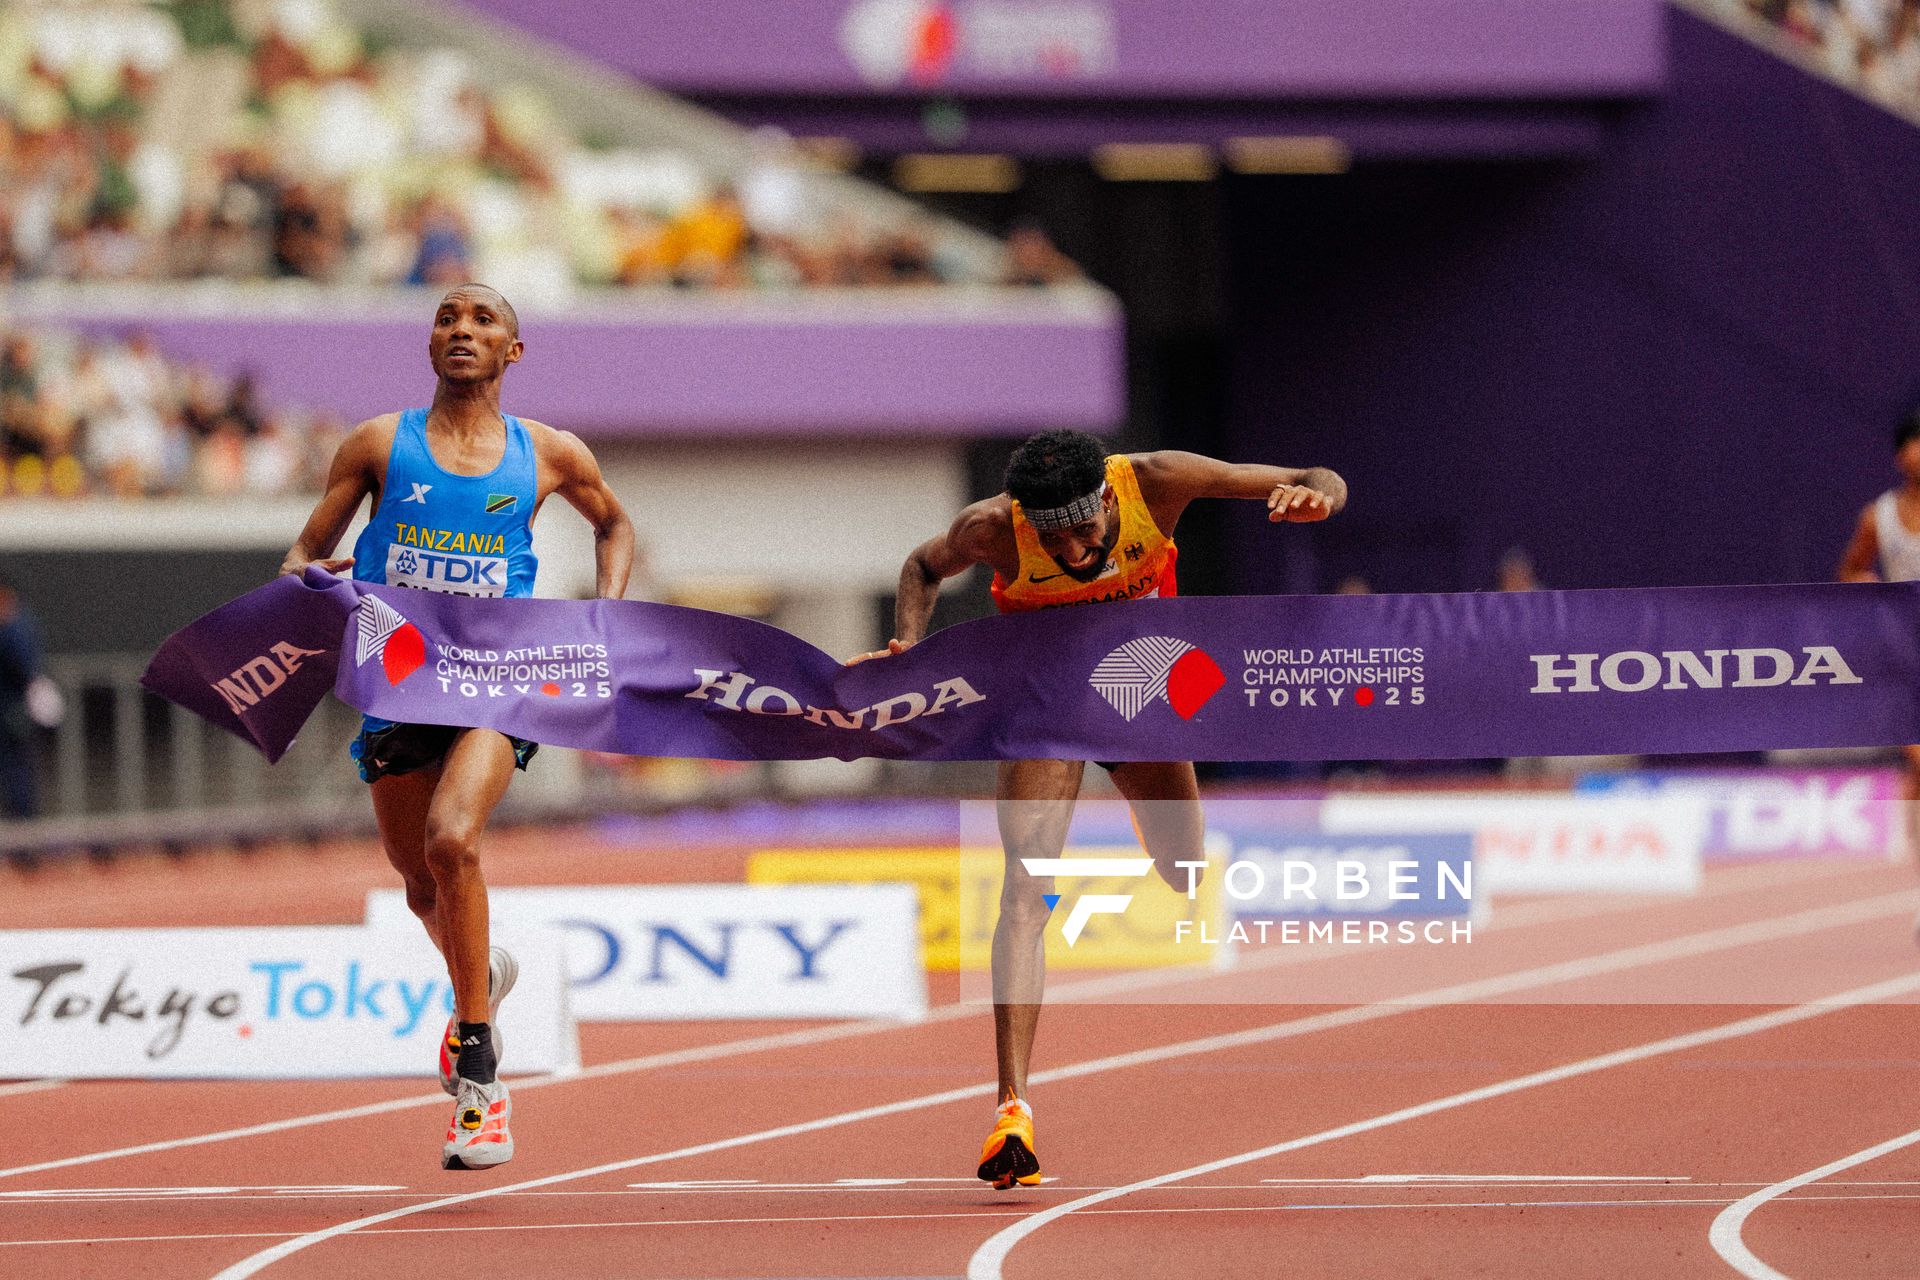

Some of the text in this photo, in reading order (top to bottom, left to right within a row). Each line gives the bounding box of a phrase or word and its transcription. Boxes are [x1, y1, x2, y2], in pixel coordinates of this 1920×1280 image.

[396, 522, 505, 554] TANZANIA
[418, 553, 499, 586] TDK
[435, 643, 608, 662] WORLD ATHLETICS
[1243, 647, 1425, 665] WORLD ATHLETICS
[210, 640, 327, 716] NDA
[436, 659, 610, 682] CHAMPIONSHIPS
[1243, 666, 1425, 686] CHAMPIONSHIPS
[1529, 645, 1864, 694] HONDA
[571, 680, 612, 698] 25
[684, 668, 987, 732] HONDA
[1385, 686, 1426, 706] 25
[554, 917, 860, 990] ONY
[11, 958, 456, 1059] Tokyo Toky
